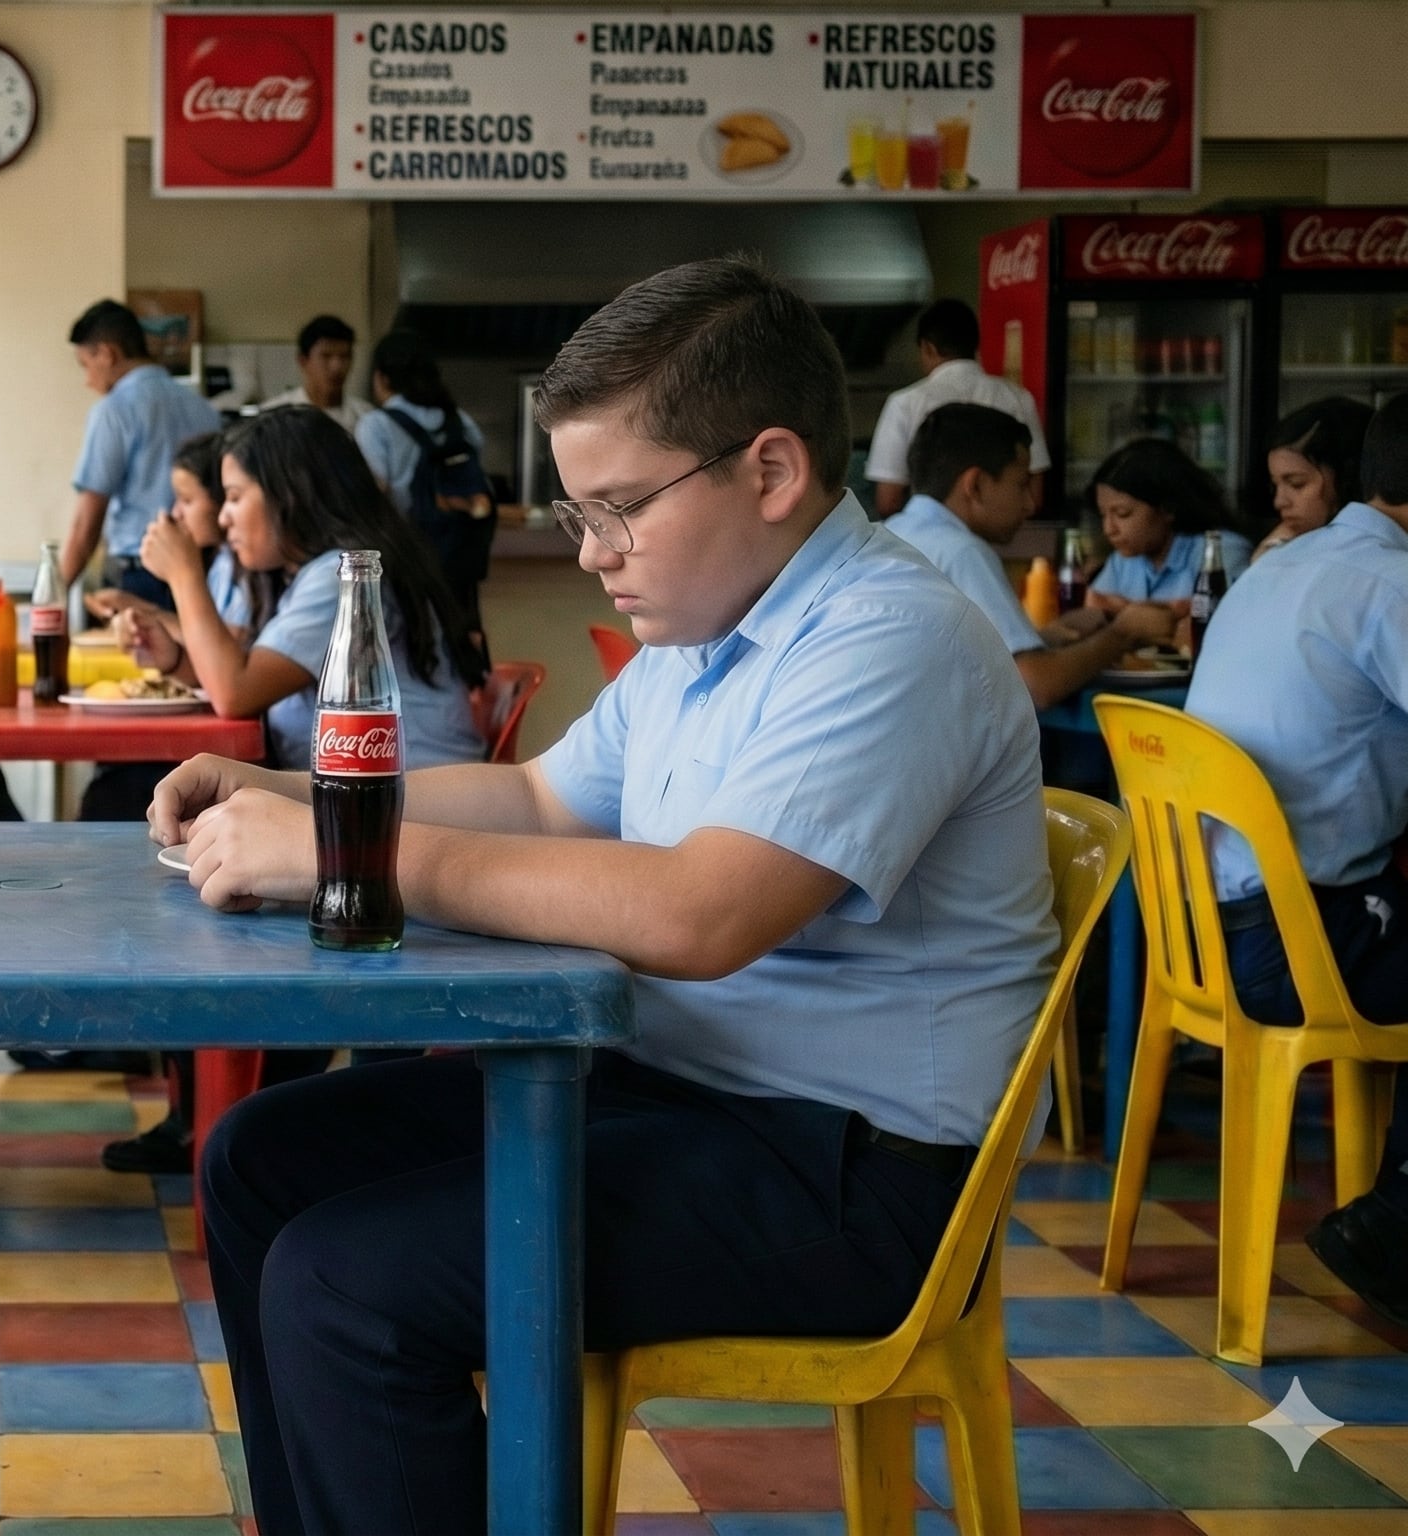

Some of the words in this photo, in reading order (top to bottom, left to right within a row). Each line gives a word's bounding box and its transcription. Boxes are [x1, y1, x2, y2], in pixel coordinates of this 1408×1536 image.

[369, 23, 507, 53] CASADOS
[593, 24, 774, 54] EMPANADAS
[825, 24, 995, 53] REFRESCOS
[825, 61, 994, 90] NATURALES
[182, 75, 313, 122] Coca-Cola
[1041, 76, 1171, 122] Coca-Cola
[370, 115, 533, 144] REFRESCOS
[369, 151, 568, 180] CARROMADOS
[1081, 220, 1241, 275] Coca-Cola
[319, 726, 397, 760] Coca-Cola
